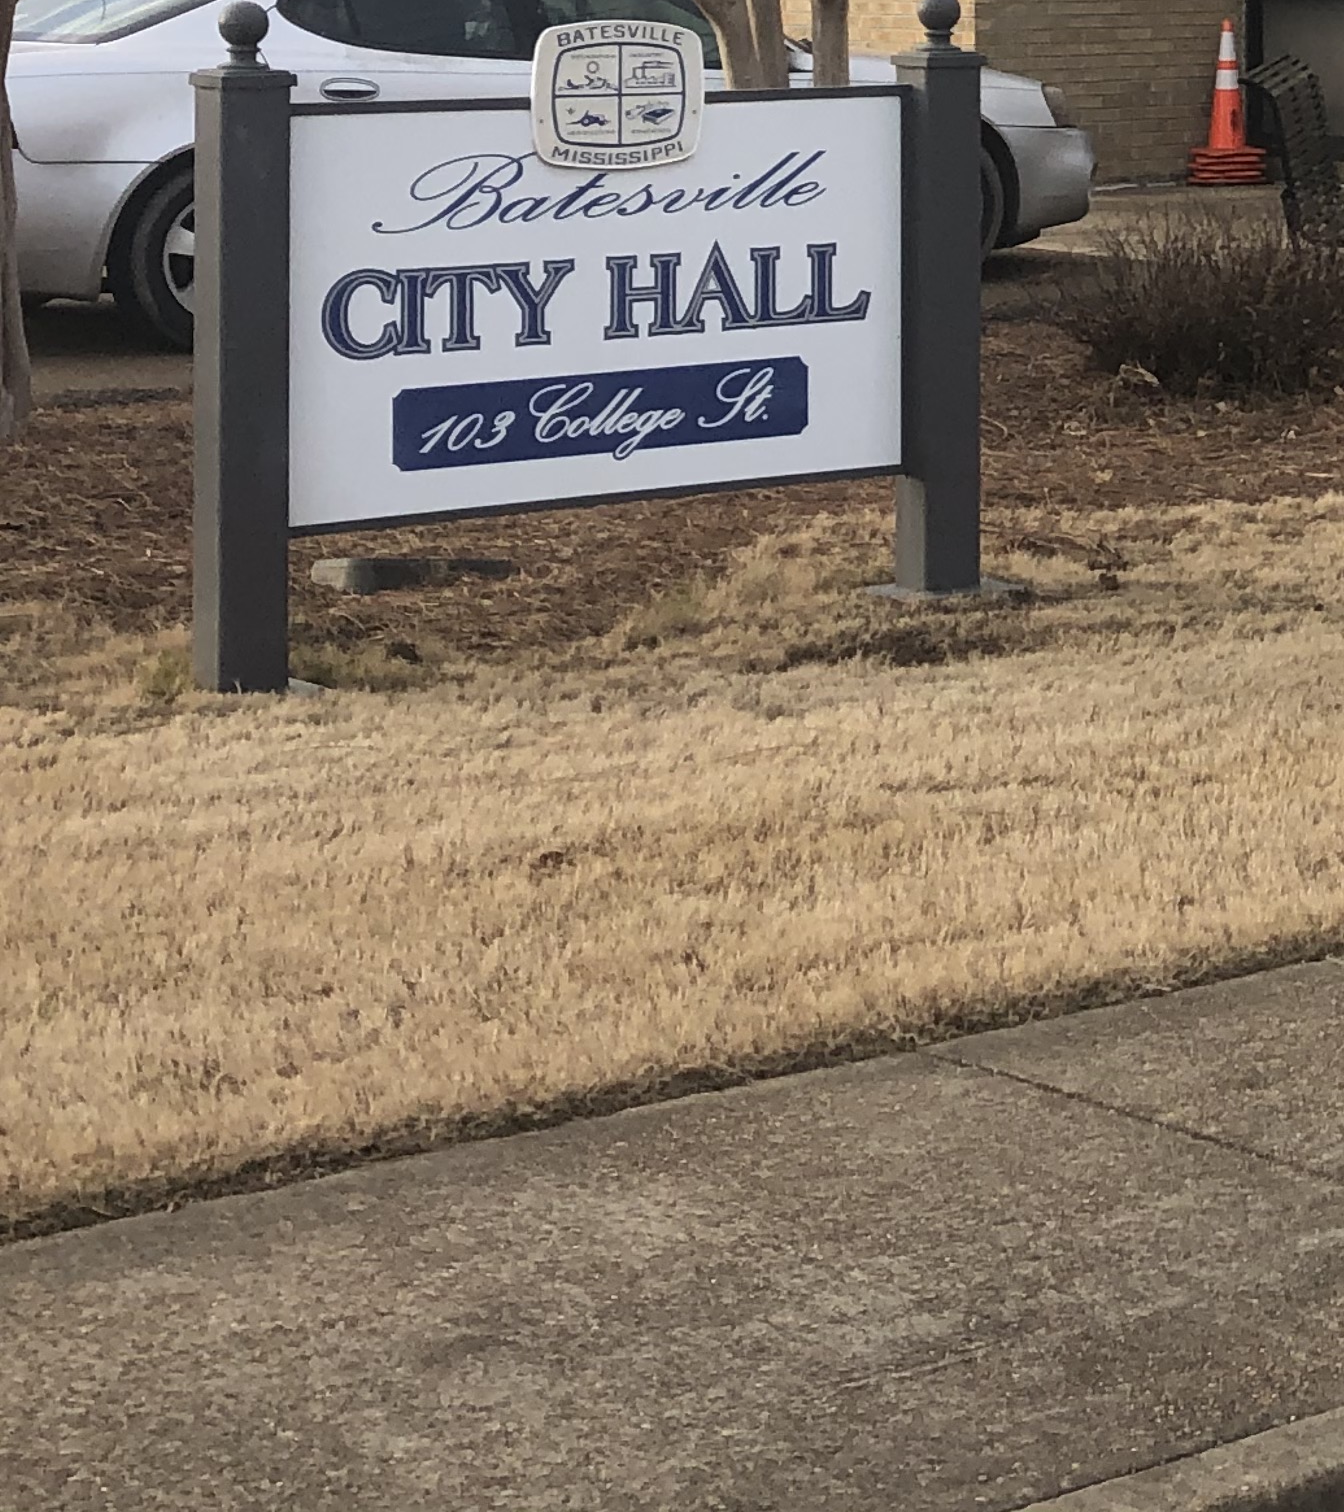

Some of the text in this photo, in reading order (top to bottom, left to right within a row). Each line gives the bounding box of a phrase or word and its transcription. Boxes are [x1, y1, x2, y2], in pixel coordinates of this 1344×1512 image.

[556, 23, 686, 48] BATESVILLE
[371, 149, 828, 234] Batesville
[551, 140, 684, 166] MISSISSIPPI
[321, 238, 872, 361] CITY HALL
[418, 366, 775, 459] 103 College St.
